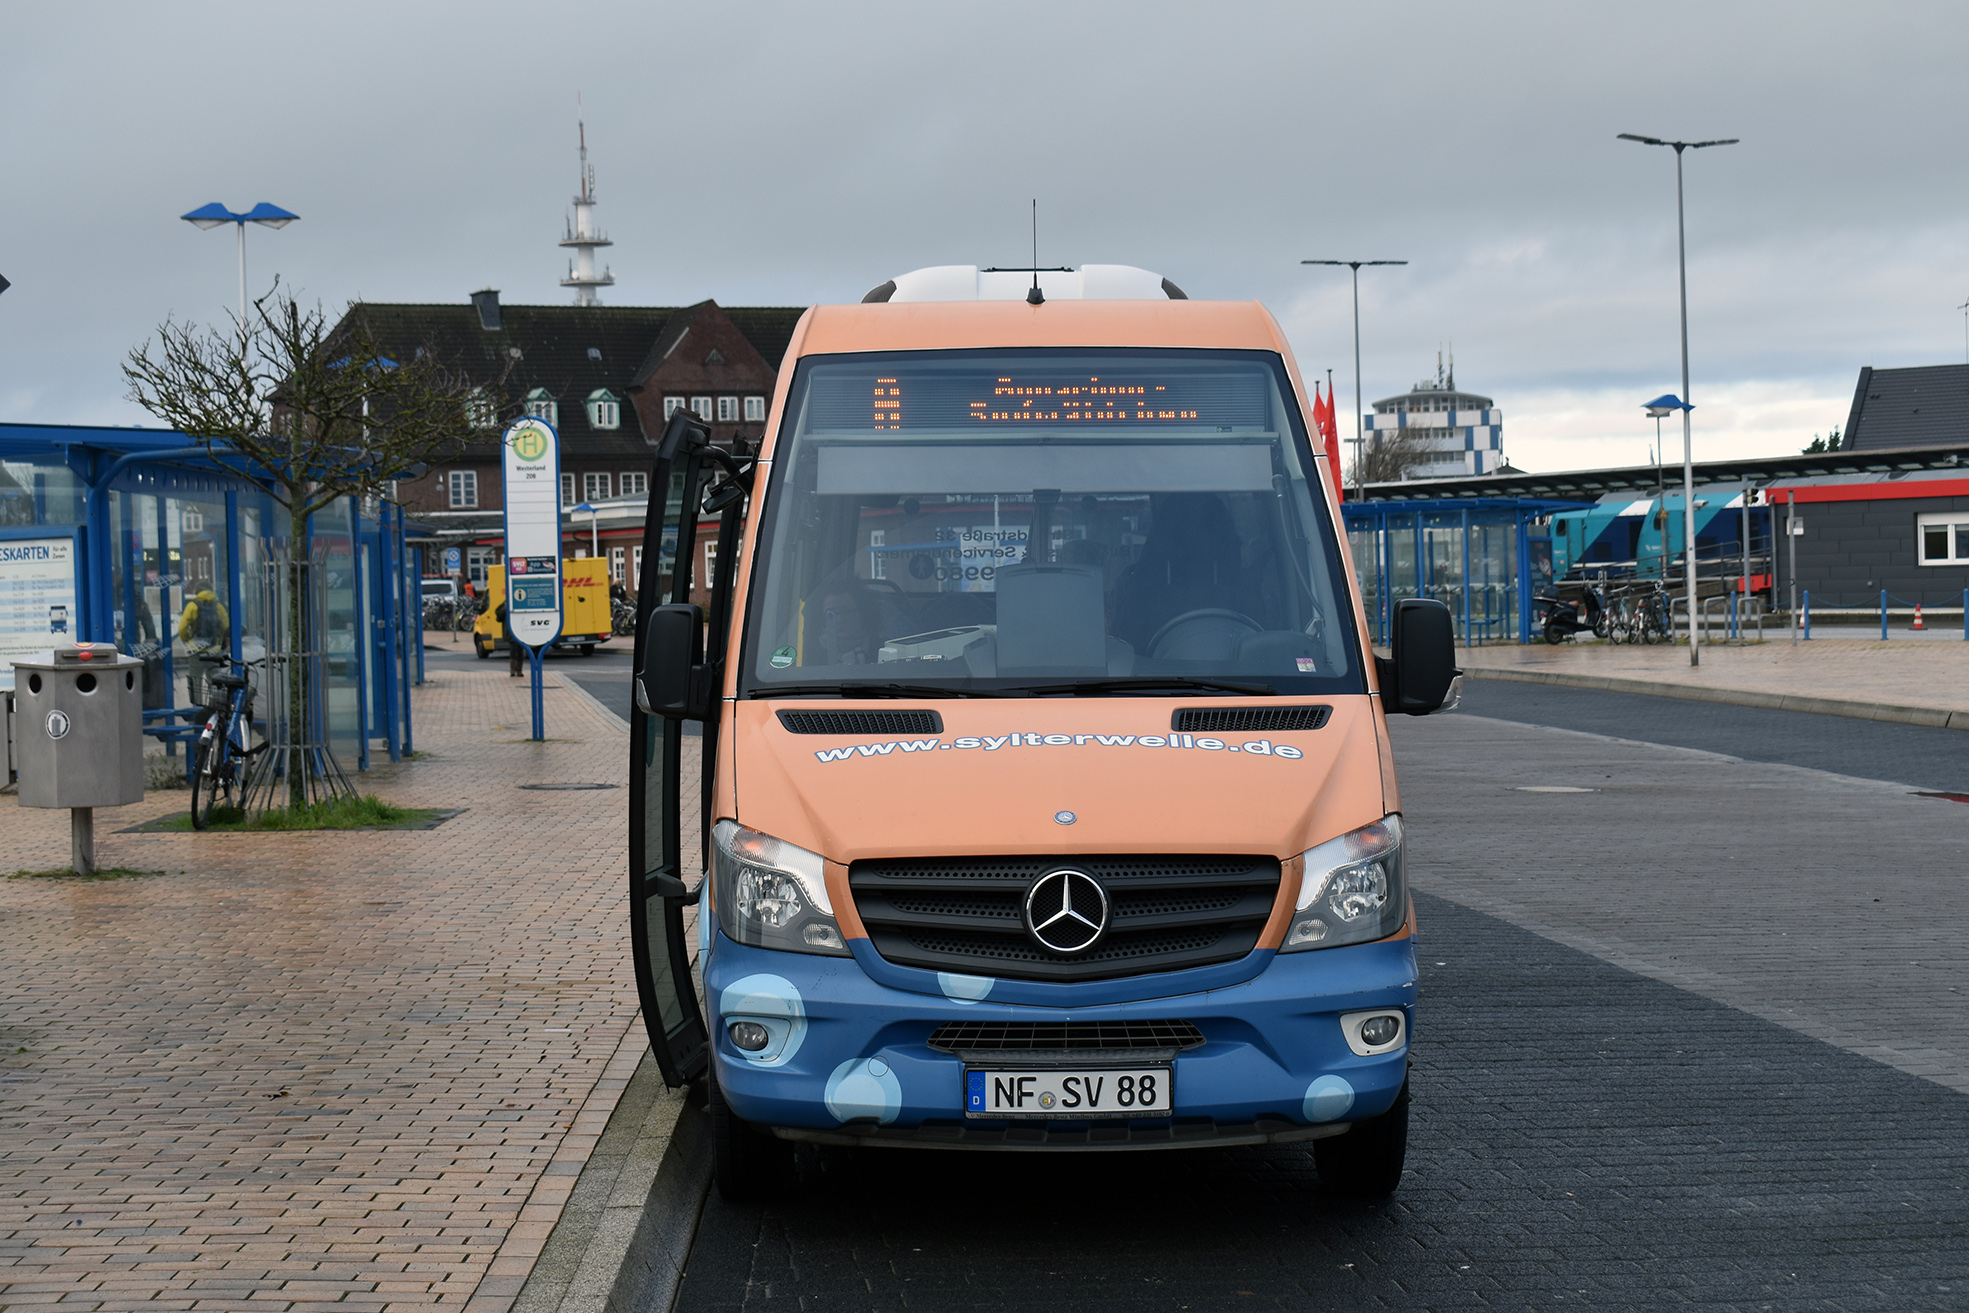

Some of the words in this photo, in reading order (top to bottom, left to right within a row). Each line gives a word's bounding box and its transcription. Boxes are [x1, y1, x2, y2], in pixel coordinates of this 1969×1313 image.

[782, 646, 791, 657] 4
[814, 732, 1304, 764] www.sylterwelle.de
[973, 1095, 981, 1105] D
[994, 1076, 1037, 1107] NF
[1061, 1076, 1104, 1107] SV
[1117, 1074, 1157, 1106] 88
